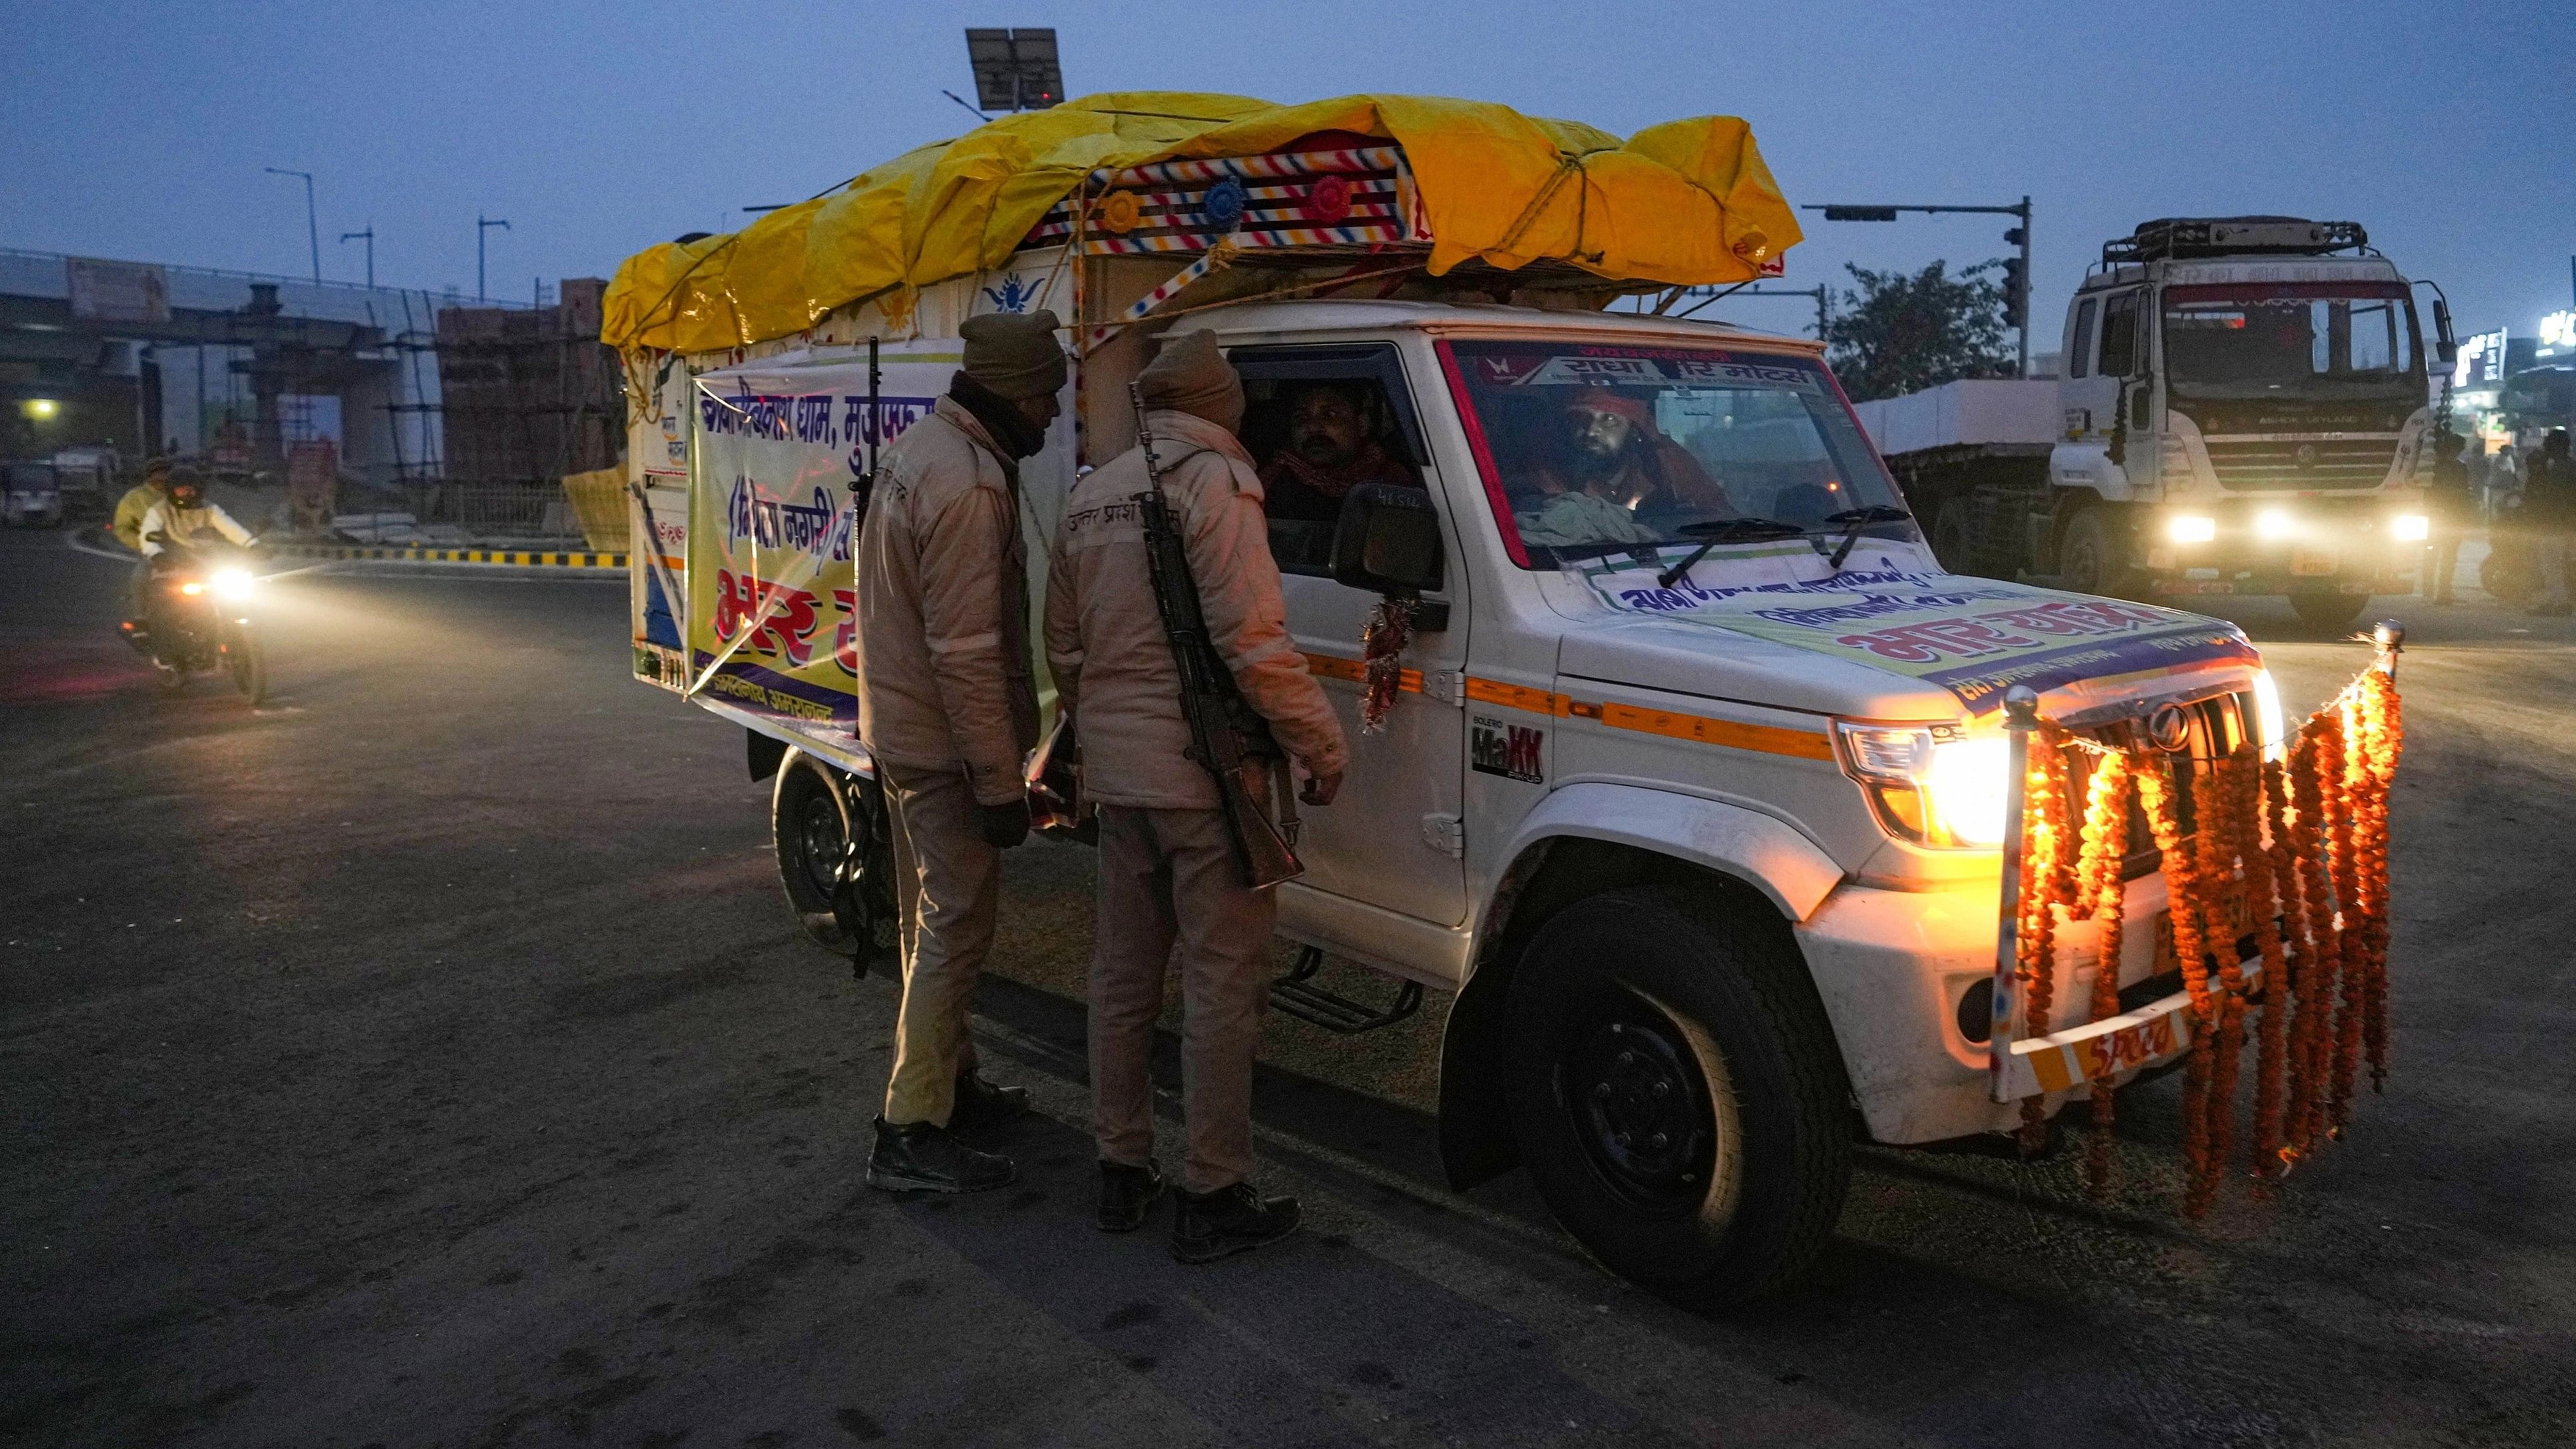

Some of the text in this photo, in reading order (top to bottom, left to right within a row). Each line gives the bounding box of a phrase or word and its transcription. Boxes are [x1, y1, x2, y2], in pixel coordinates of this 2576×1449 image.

[716, 568, 823, 668] भार
[1835, 616, 2045, 664] भार
[1473, 716, 1503, 728] BOLERO
